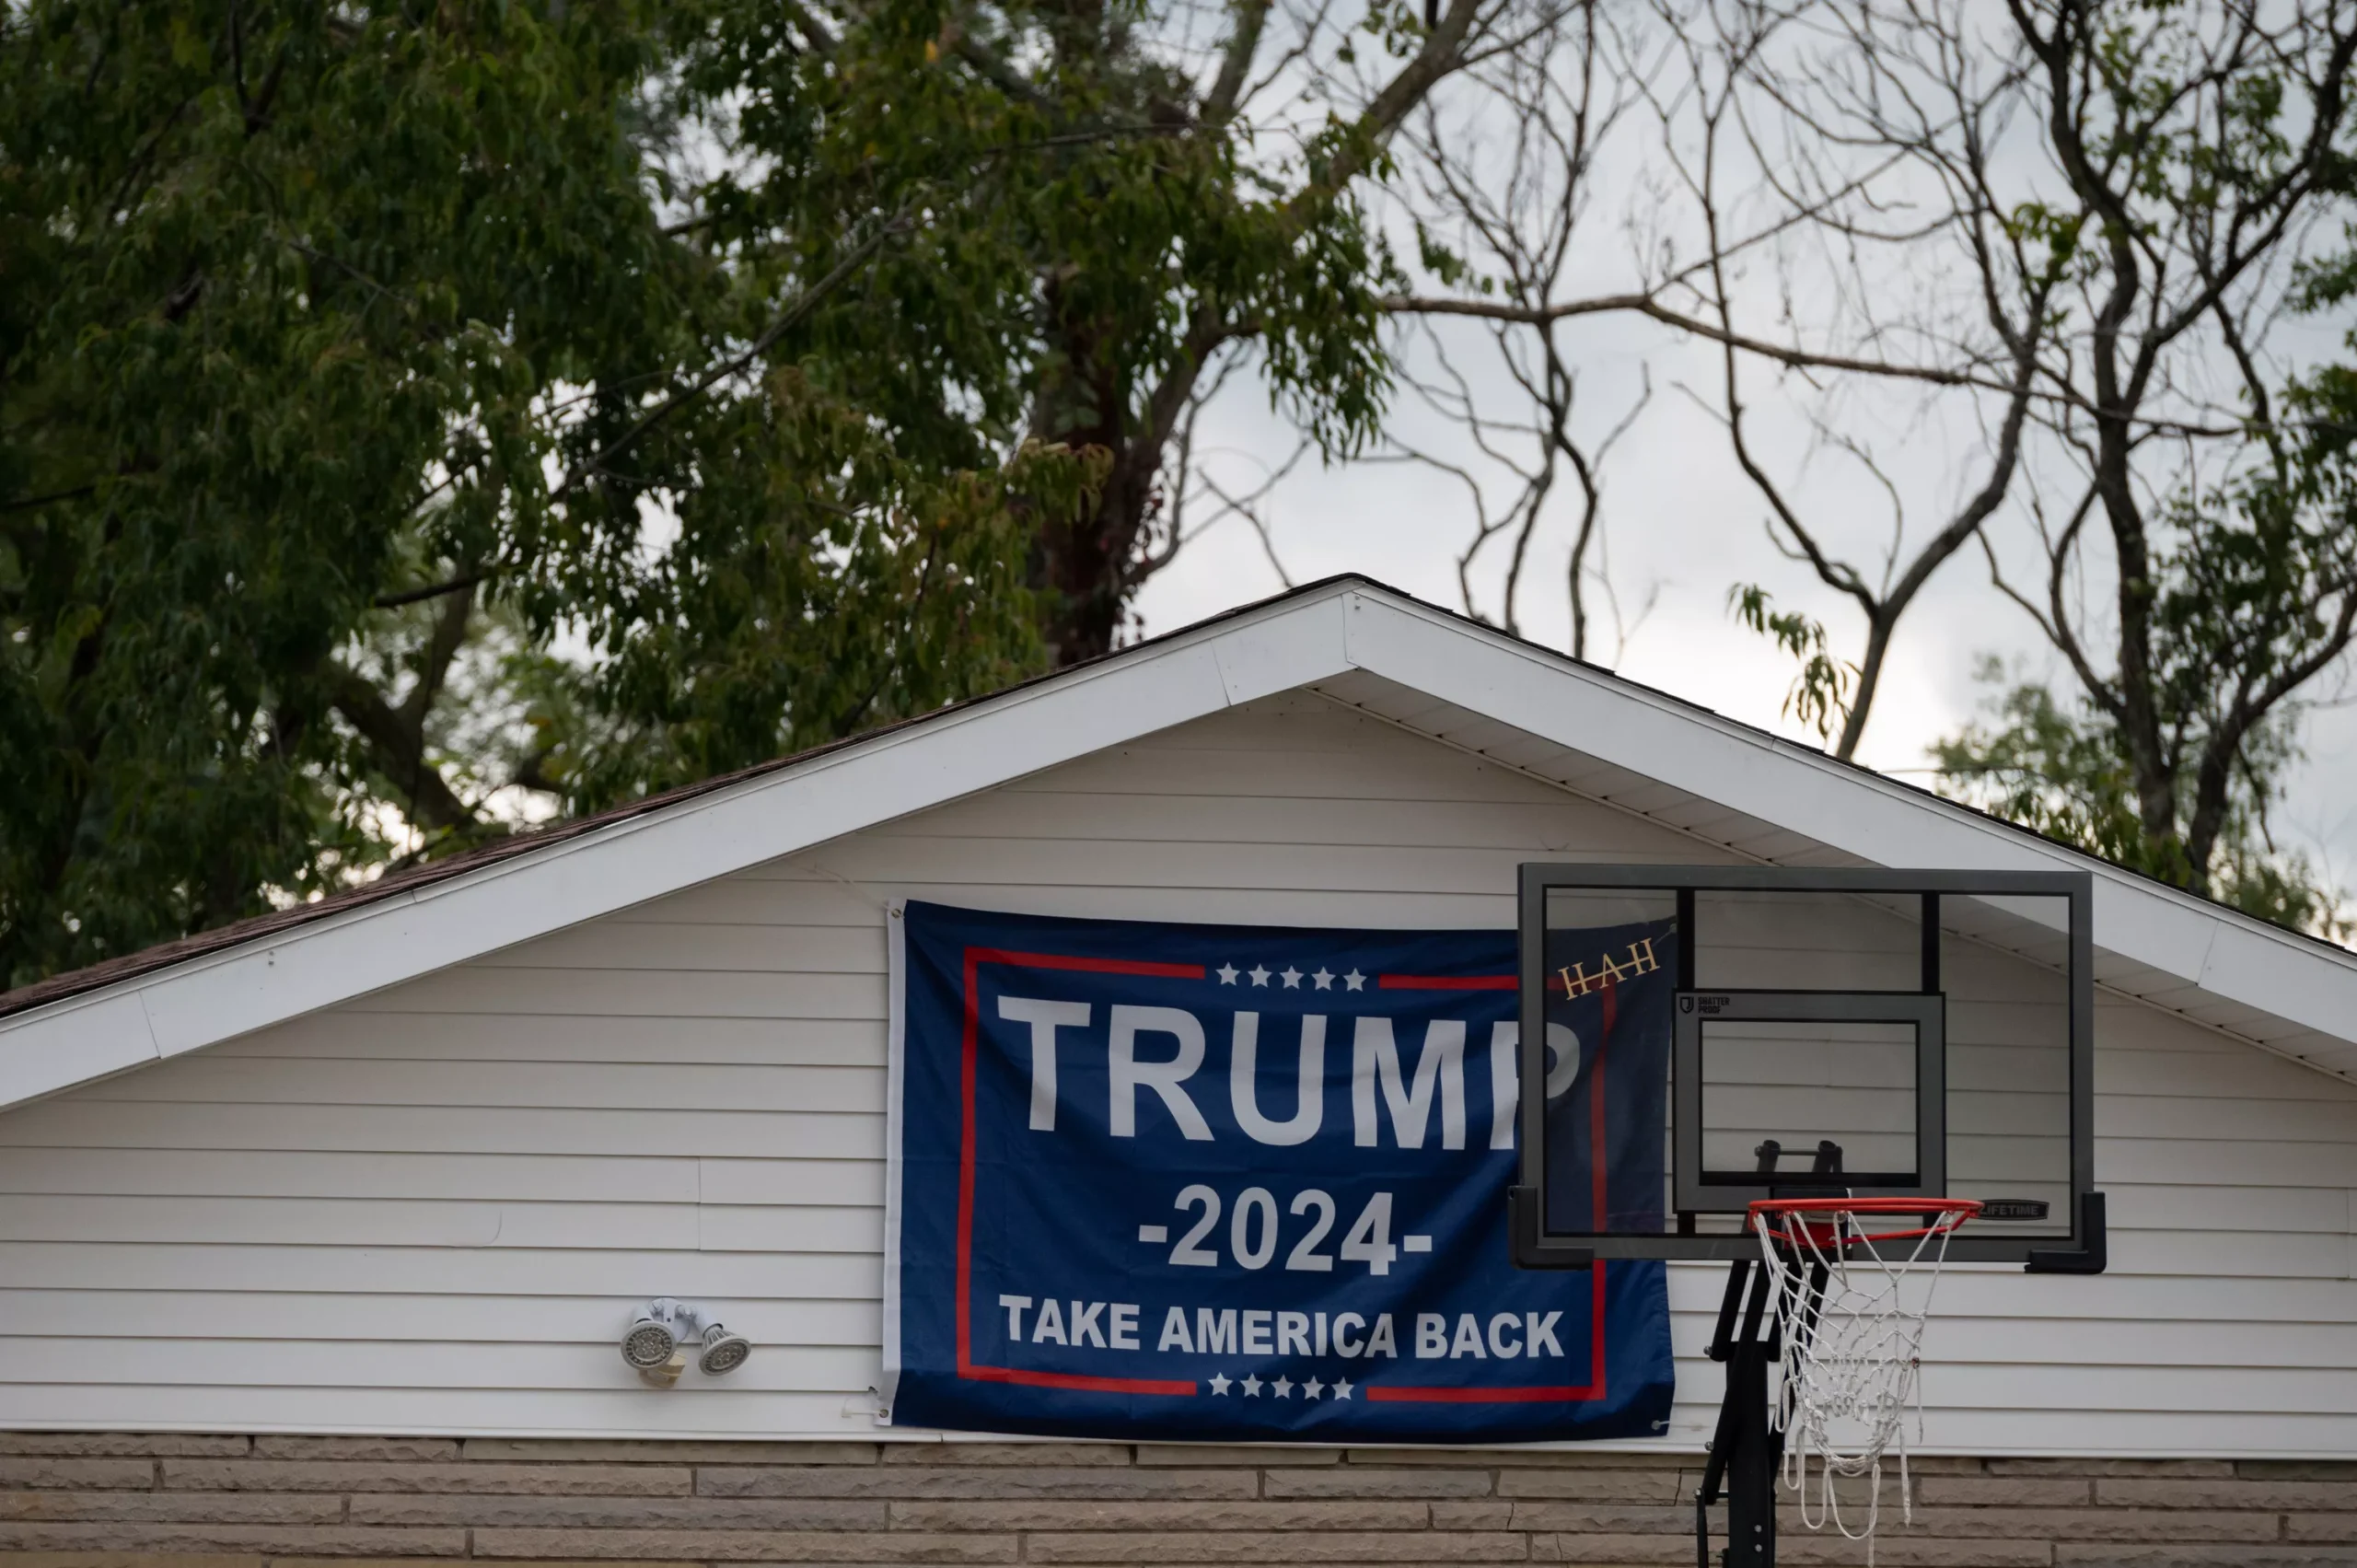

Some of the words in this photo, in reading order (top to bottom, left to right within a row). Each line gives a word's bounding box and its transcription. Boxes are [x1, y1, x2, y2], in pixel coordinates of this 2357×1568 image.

[1697, 996, 1731, 1006] SHATTER
[1697, 1005, 1722, 1015] PROOF
[997, 995, 1581, 1152] TRUMP
[998, 1294, 1141, 1351] TAKE
[1156, 1307, 1398, 1359] AMERICA
[1414, 1310, 1565, 1359] BACK
